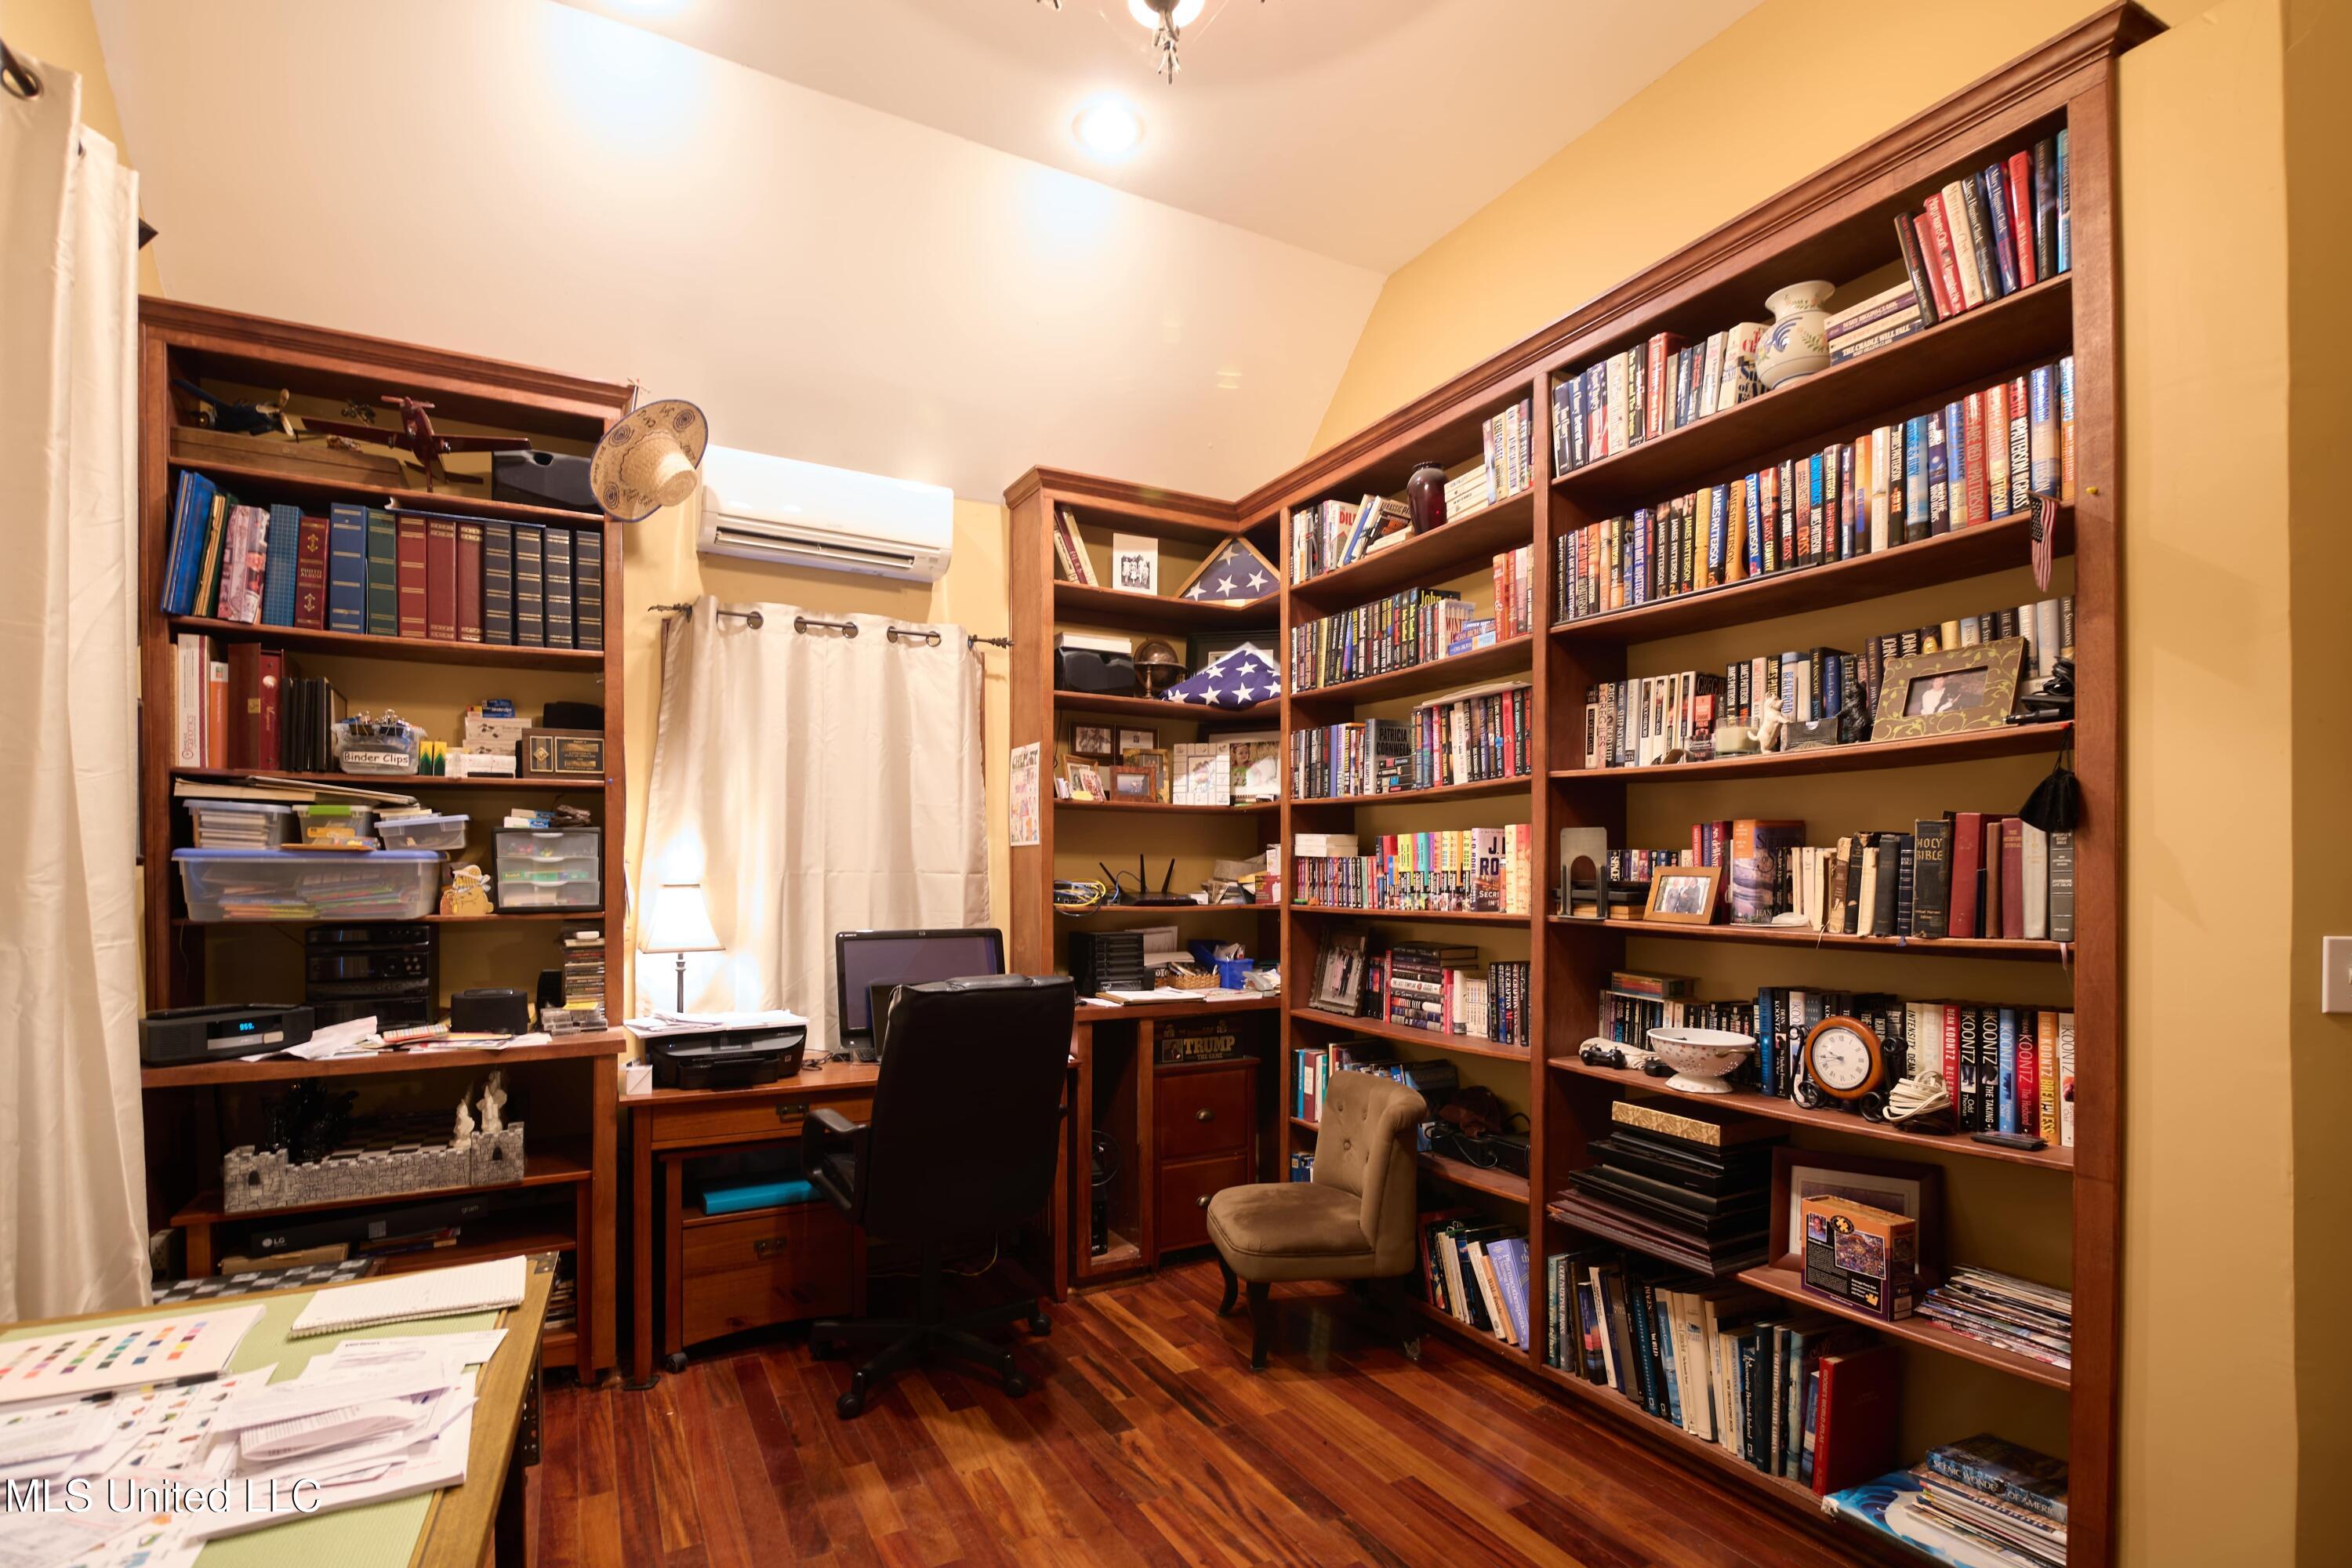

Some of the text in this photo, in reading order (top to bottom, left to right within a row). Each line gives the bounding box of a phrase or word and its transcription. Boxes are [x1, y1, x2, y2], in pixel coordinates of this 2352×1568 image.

[1965, 180, 1985, 245] Mary Higgins Clark
[1989, 169, 2009, 234] Mary Higgins Clark
[1572, 392, 1582, 415] Clancy
[1494, 419, 1503, 461] KEN FOLLETT
[1891, 430, 1902, 481] JAMES PATTERSON
[2011, 426, 2029, 474] PATTERSON
[1519, 441, 1528, 478] FOLLETT
[1907, 458, 1919, 477] JURY
[1967, 426, 1984, 521] ARE RED PATTERSON
[1380, 501, 1403, 516] JURASSIC
[1991, 470, 2008, 514] PATTERSON
[1709, 489, 1722, 568] JAMES PATTERSON
[1726, 485, 1738, 564] JAMES PATTERSON
[1745, 478, 1759, 558] JAMES PATTERSON
[1781, 484, 1792, 561] PATTERSON DOUBLE CROSS
[1810, 508, 1821, 555] JAMES PATTERSON
[1633, 511, 1645, 605] FOUR PATTERSON
[1669, 518, 1680, 583] JAMES PATTERSON
[1683, 516, 1693, 582] JAMES PATTERSON
[1764, 518, 1774, 572] CROSS COUNTRY
[1798, 525, 1809, 557] CROSS
[1657, 545, 1666, 586] PATTERSON
[1420, 590, 1443, 608] John
[1494, 601, 1504, 612] &
[1577, 560, 1588, 616] WOLF PATTERSON
[2002, 612, 2011, 626] THE
[2063, 612, 2073, 646] SUMMONS
[1882, 638, 1897, 658] JOHN
[1902, 633, 1916, 655] JOHN
[1727, 666, 1737, 706] JAMES PATTERSON
[1740, 663, 1749, 705] JAMES PATTERSON
[1767, 659, 1778, 678] JAMES
[1782, 671, 1793, 695] BEACH
[1845, 660, 1854, 679] THE
[1606, 683, 1615, 700] GREG
[1380, 727, 1407, 742] PATRICIA
[1598, 694, 1607, 747] GREG ILES
[1616, 709, 1625, 757] SLEEP MORE
[343, 753, 409, 768] Binder Clips
[1377, 742, 1411, 757] CORNWELL
[1916, 850, 1943, 861] BIBLE
[1917, 838, 1943, 848] HOLY
[1610, 855, 1620, 880] SPACE
[1504, 1011, 1513, 1019] M
[1183, 1035, 1236, 1054] TRUMP
[1907, 1010, 1916, 1072] INTENSITY DEAN
[1945, 1008, 1956, 1060] DEAN KOONTZ
[1962, 1014, 1976, 1065] KOONTZ
[1999, 1025, 2013, 1072] KOONTZ
[2060, 1028, 2074, 1074] KOONTZ
[1983, 1014, 1998, 1123] KOONTZ THE TAKING
[2019, 1033, 2033, 1083] KOONTZ
[2040, 1016, 2056, 1134] DEAN KOONTZ BREATHLESS
[2005, 1100, 2013, 1123] Forever
[2020, 1087, 2031, 1100] The
[2021, 1100, 2031, 1126] Husband
[461, 1204, 480, 1214] gram
[273, 1236, 286, 1245] LG
[1486, 1278, 1503, 1315] Wild Foods
[1650, 1333, 1659, 1357] WORLD
[1743, 1355, 1755, 1391] Discovering
[1818, 1422, 1827, 1445] ATLAS
[1933, 1459, 2063, 1519] SCENIC WONDES OF AMERICA
